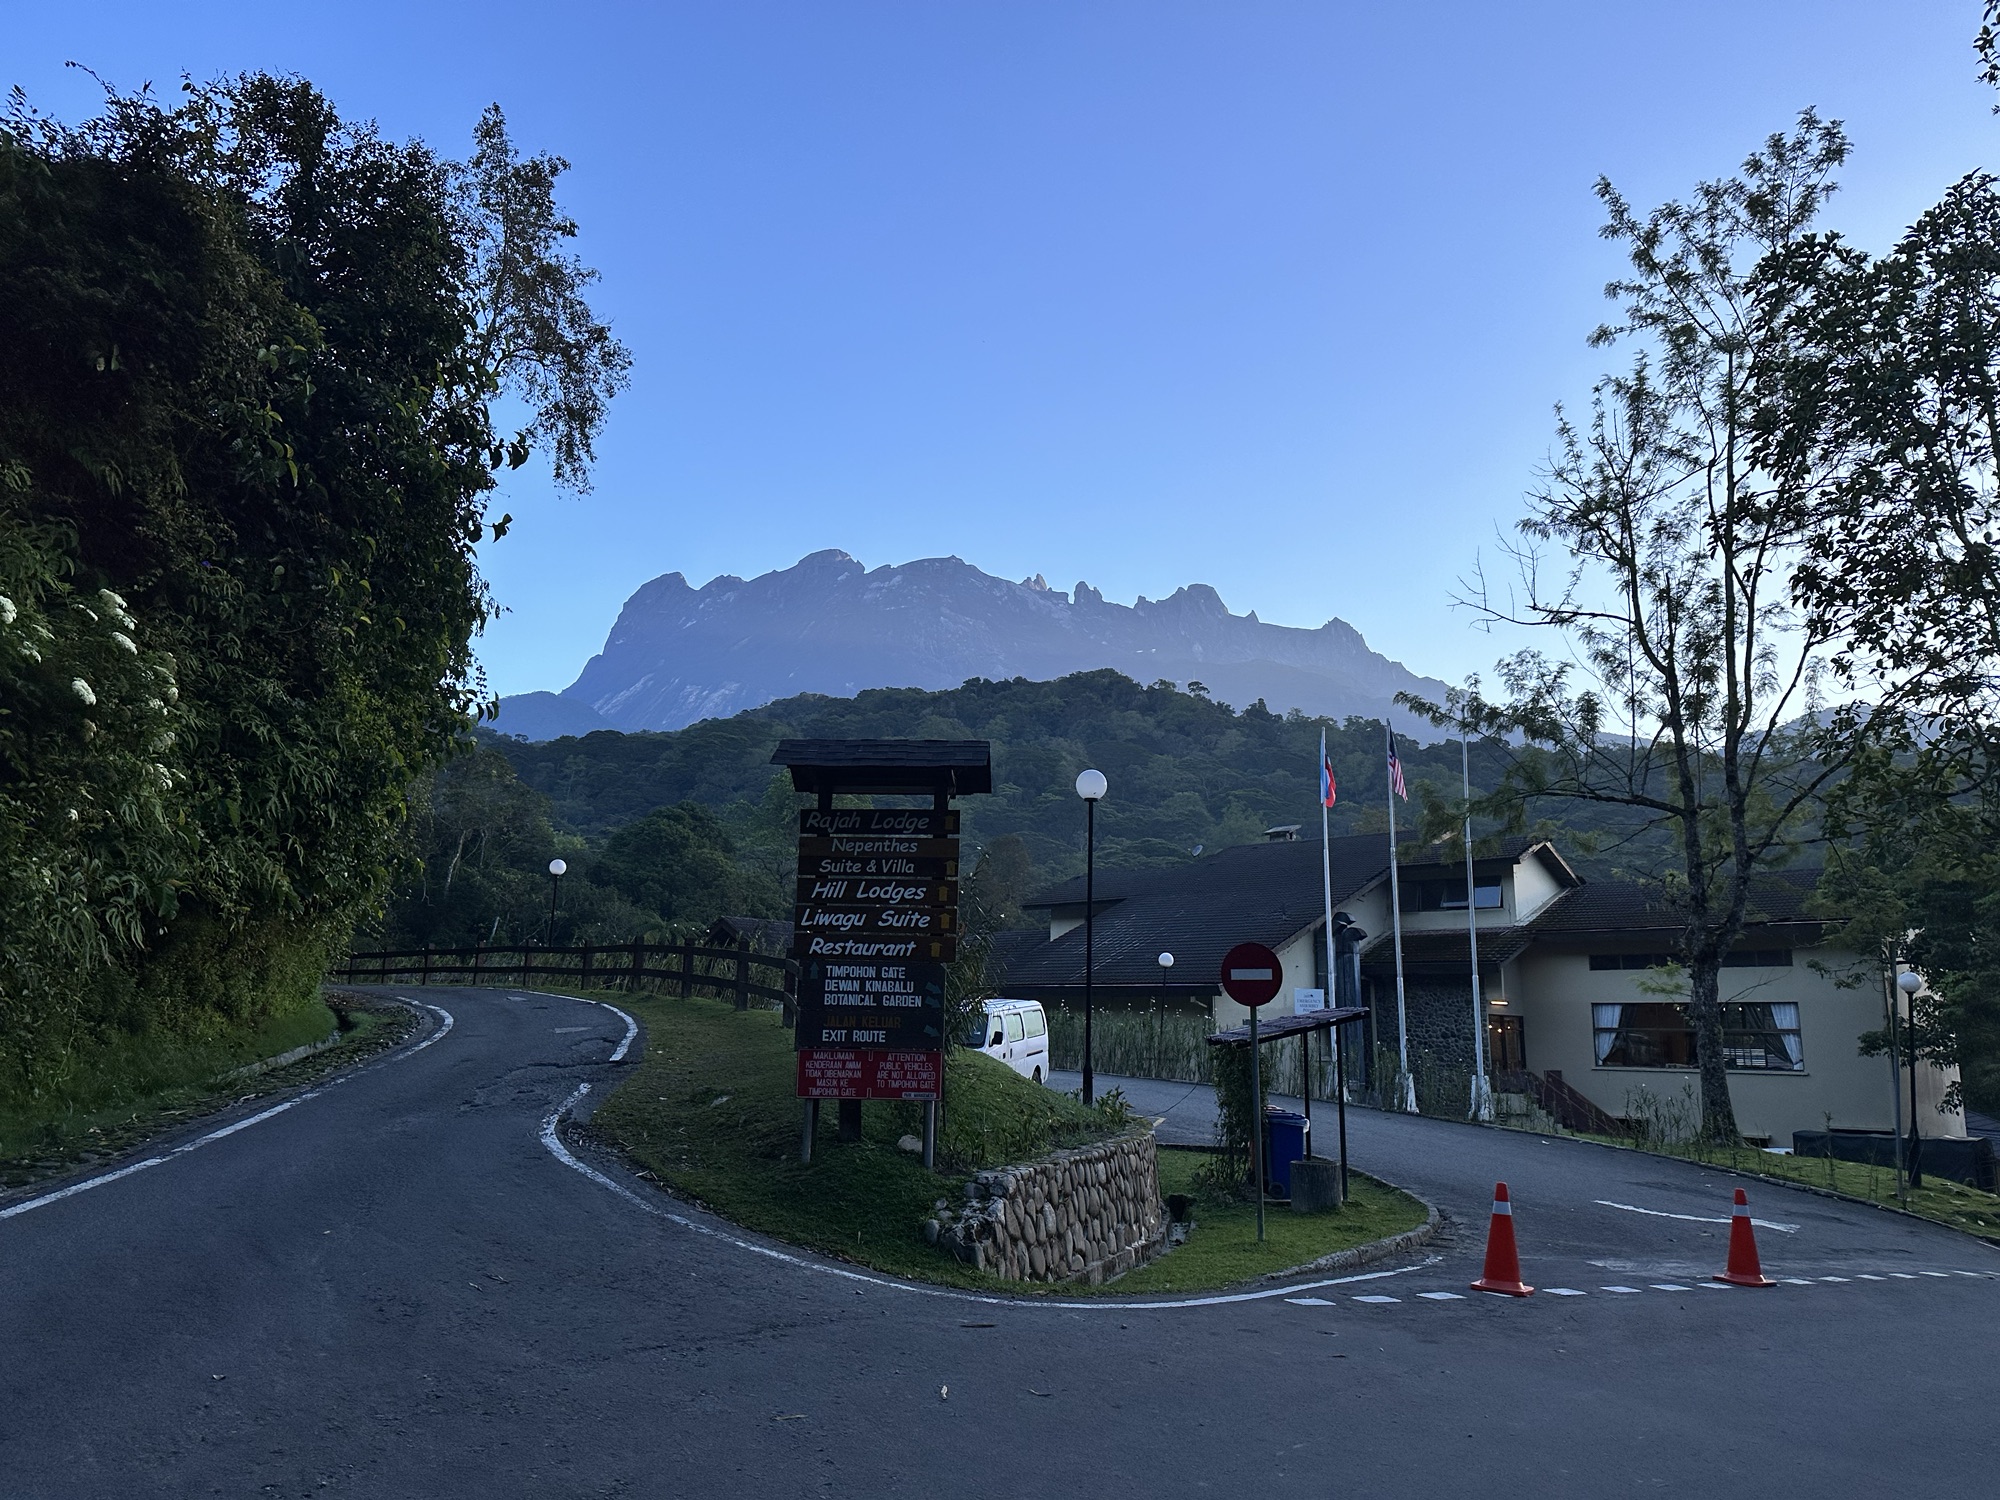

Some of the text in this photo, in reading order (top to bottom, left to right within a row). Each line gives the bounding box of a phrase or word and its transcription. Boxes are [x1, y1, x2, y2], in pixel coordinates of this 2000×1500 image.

[806, 812, 930, 834] Rajah Lodge
[831, 838, 918, 856] Nepenthes
[819, 859, 915, 873] Suite & Villa
[811, 881, 927, 904] Hill Lodges
[801, 908, 931, 931] Liwagu Suite
[809, 937, 917, 957] Restaurant
[826, 965, 906, 979] TIMPOHON GATE
[825, 979, 914, 993] DEWAN KINABALU
[824, 994, 922, 1008] BOTANICAL GARDEN
[824, 1015, 901, 1028] JALAN KELUAR
[822, 1030, 887, 1043] EXIT ROUTE
[813, 1051, 855, 1060] MAKLUMAN
[887, 1053, 926, 1062] ATTENTION
[805, 1061, 842, 1069] KENDERAAN
[879, 1061, 933, 1070] PUBLIC VEHICLES
[805, 1069, 862, 1078] TIDAK DIBENARKAN
[877, 1071, 936, 1080] ARE NOT ALLOWED
[816, 1078, 848, 1087] MASUK KE
[877, 1080, 935, 1089] TO TIMPOHON GATE
[808, 1087, 857, 1096] TIMPOHON GATE
